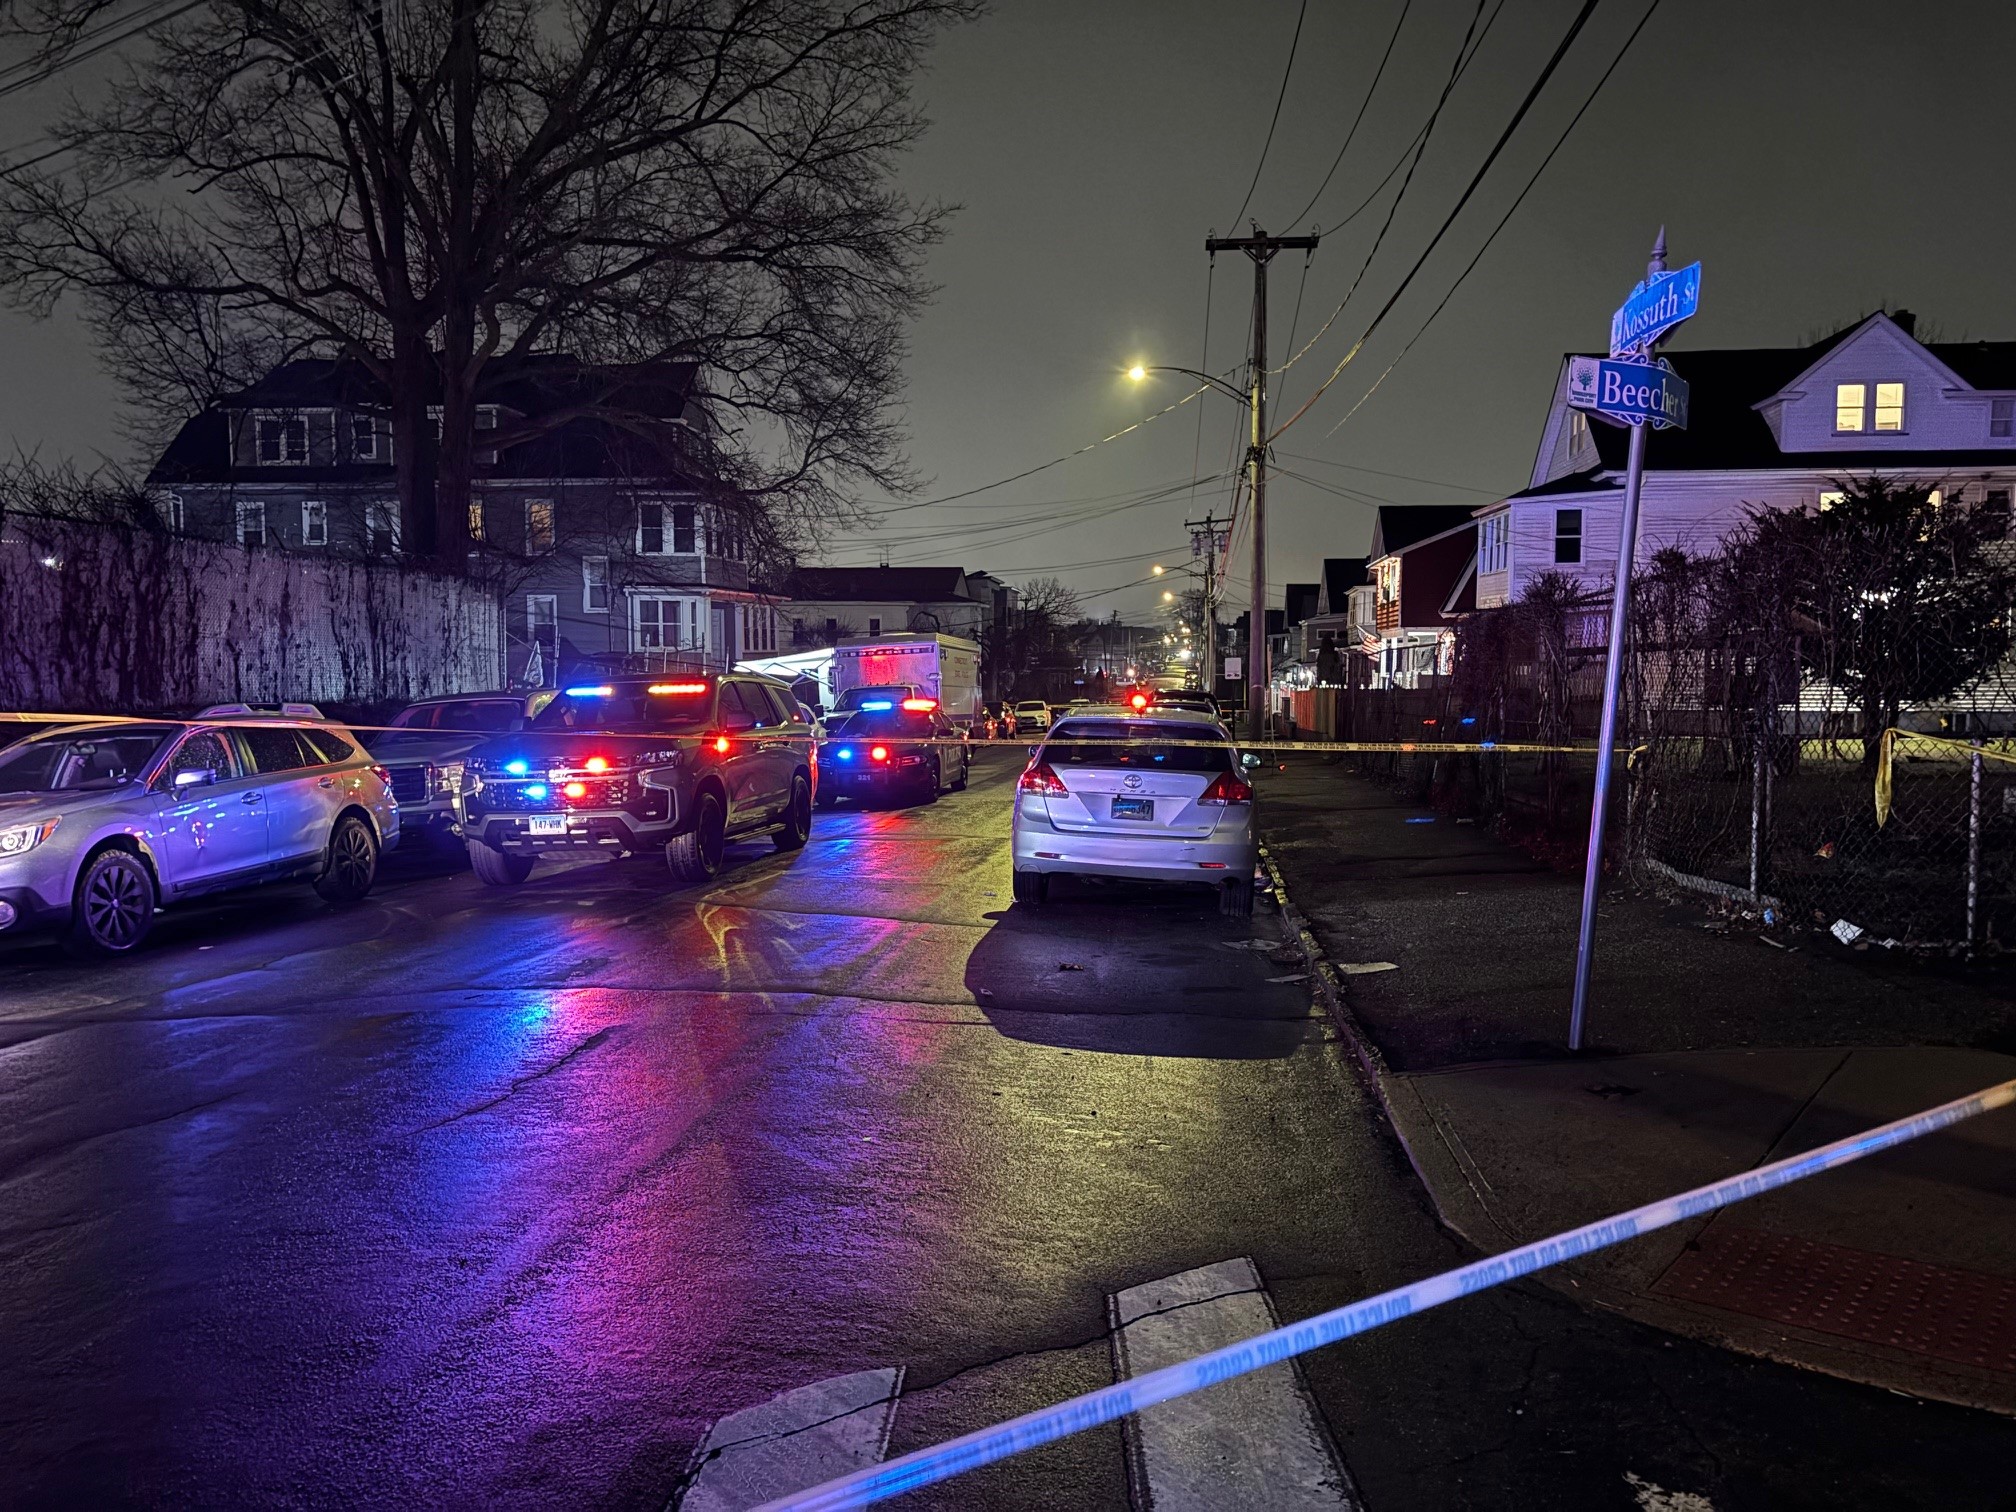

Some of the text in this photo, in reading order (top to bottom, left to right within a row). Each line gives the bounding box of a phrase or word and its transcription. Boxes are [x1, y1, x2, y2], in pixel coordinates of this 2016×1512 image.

[1622, 281, 1696, 342] Kossuth St
[1602, 370, 1678, 417] Beecher
